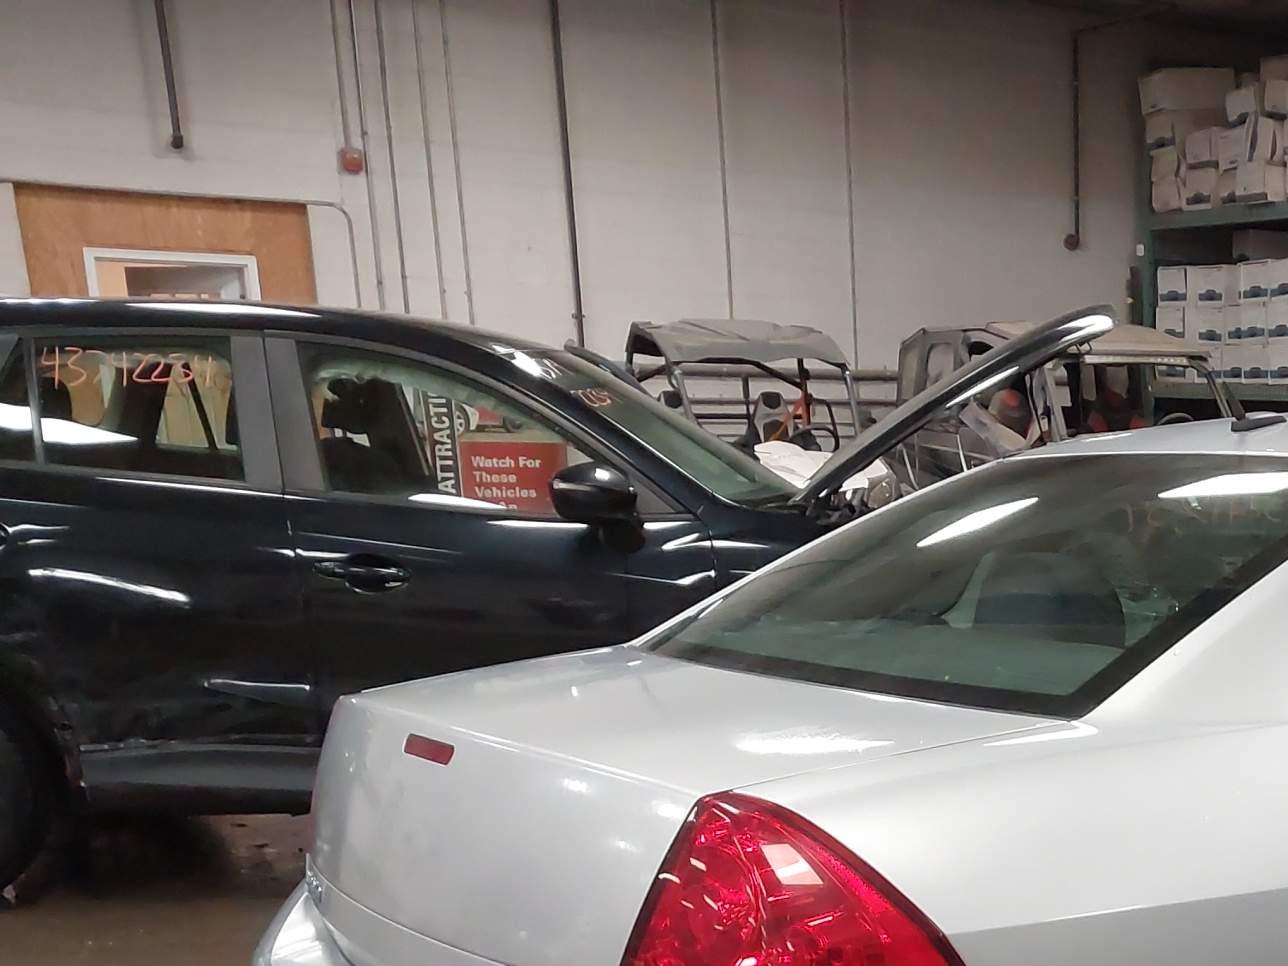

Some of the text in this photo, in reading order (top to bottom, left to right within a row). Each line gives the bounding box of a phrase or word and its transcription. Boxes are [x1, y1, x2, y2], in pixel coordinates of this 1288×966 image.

[428, 392, 457, 494] ATTRACTI
[471, 456, 542, 468] Watch For
[473, 471, 517, 483] These
[474, 486, 537, 498] Vehicles
